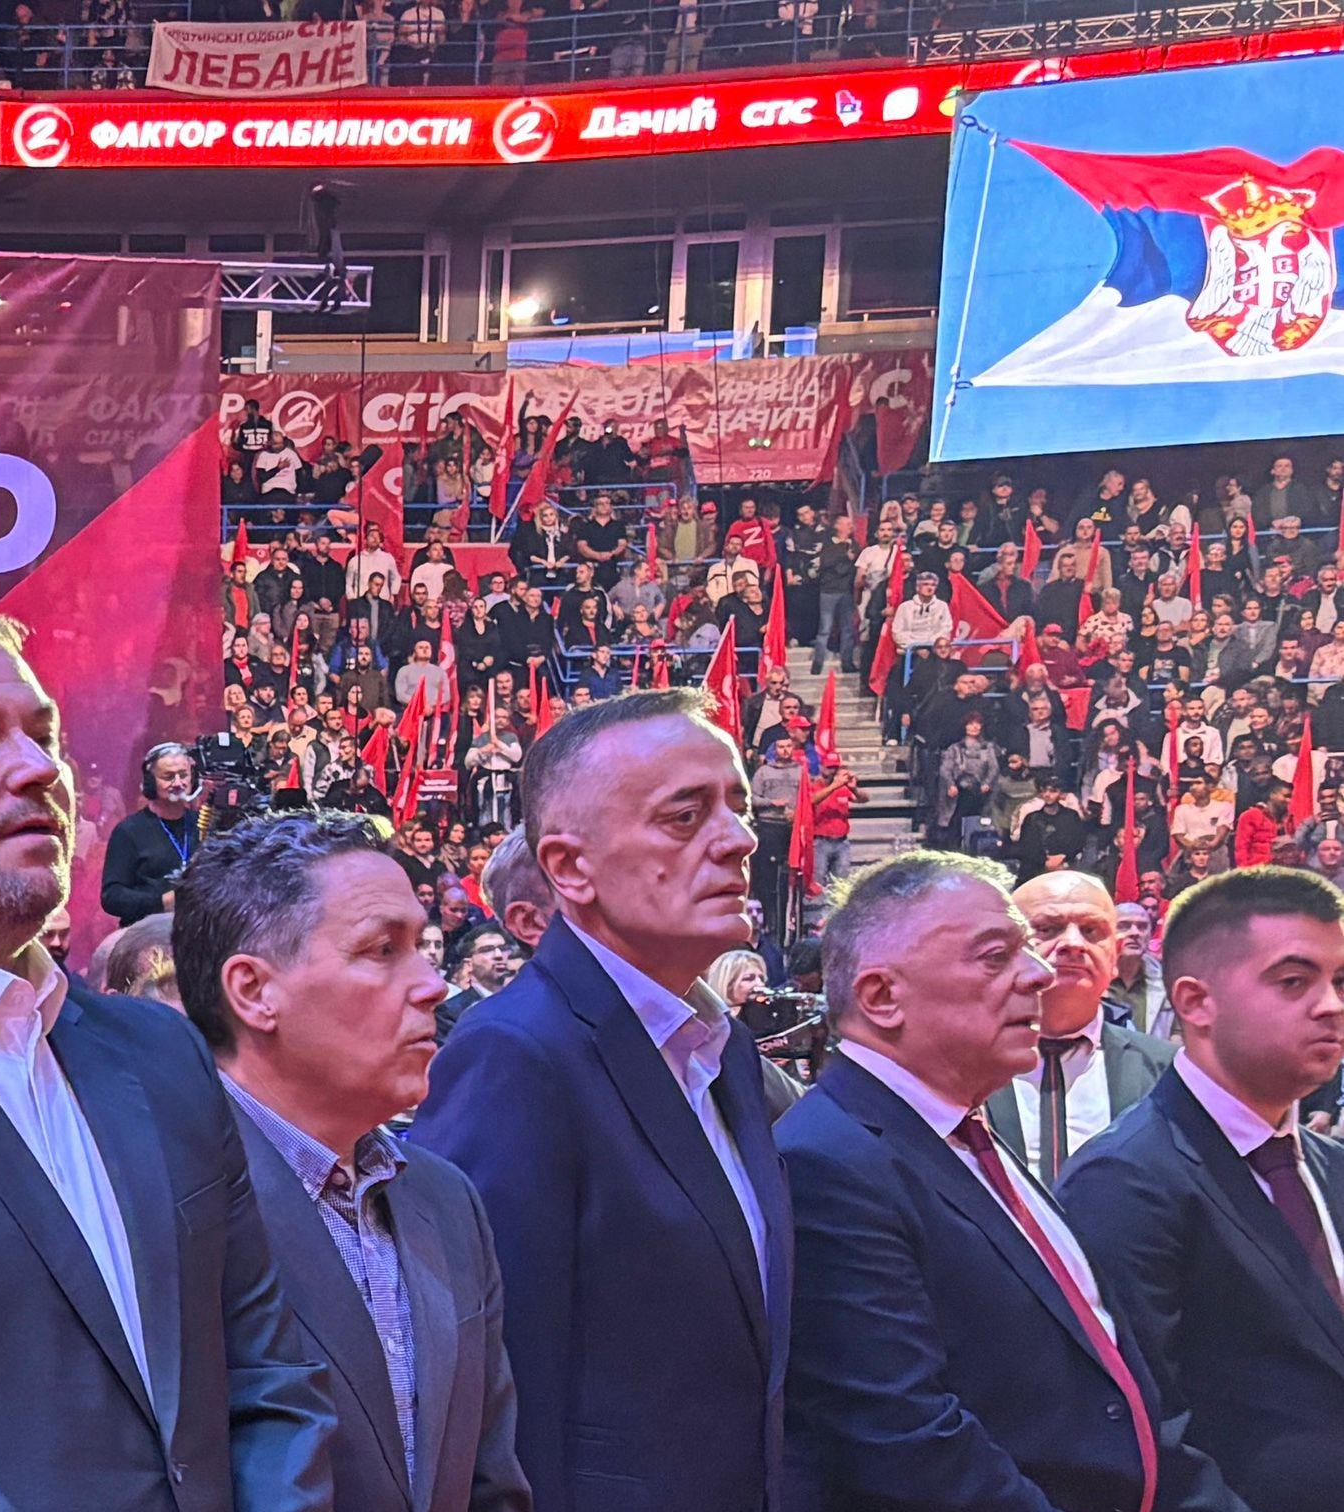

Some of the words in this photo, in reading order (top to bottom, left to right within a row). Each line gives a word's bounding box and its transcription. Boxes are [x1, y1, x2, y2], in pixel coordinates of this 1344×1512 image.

[163, 41, 356, 90] ЛЕБАНЕ
[90, 119, 226, 150] ФАКТОР
[232, 117, 473, 149] СТАБИЛНОСТИ
[579, 96, 717, 139] Дачић
[741, 97, 818, 128] СПС
